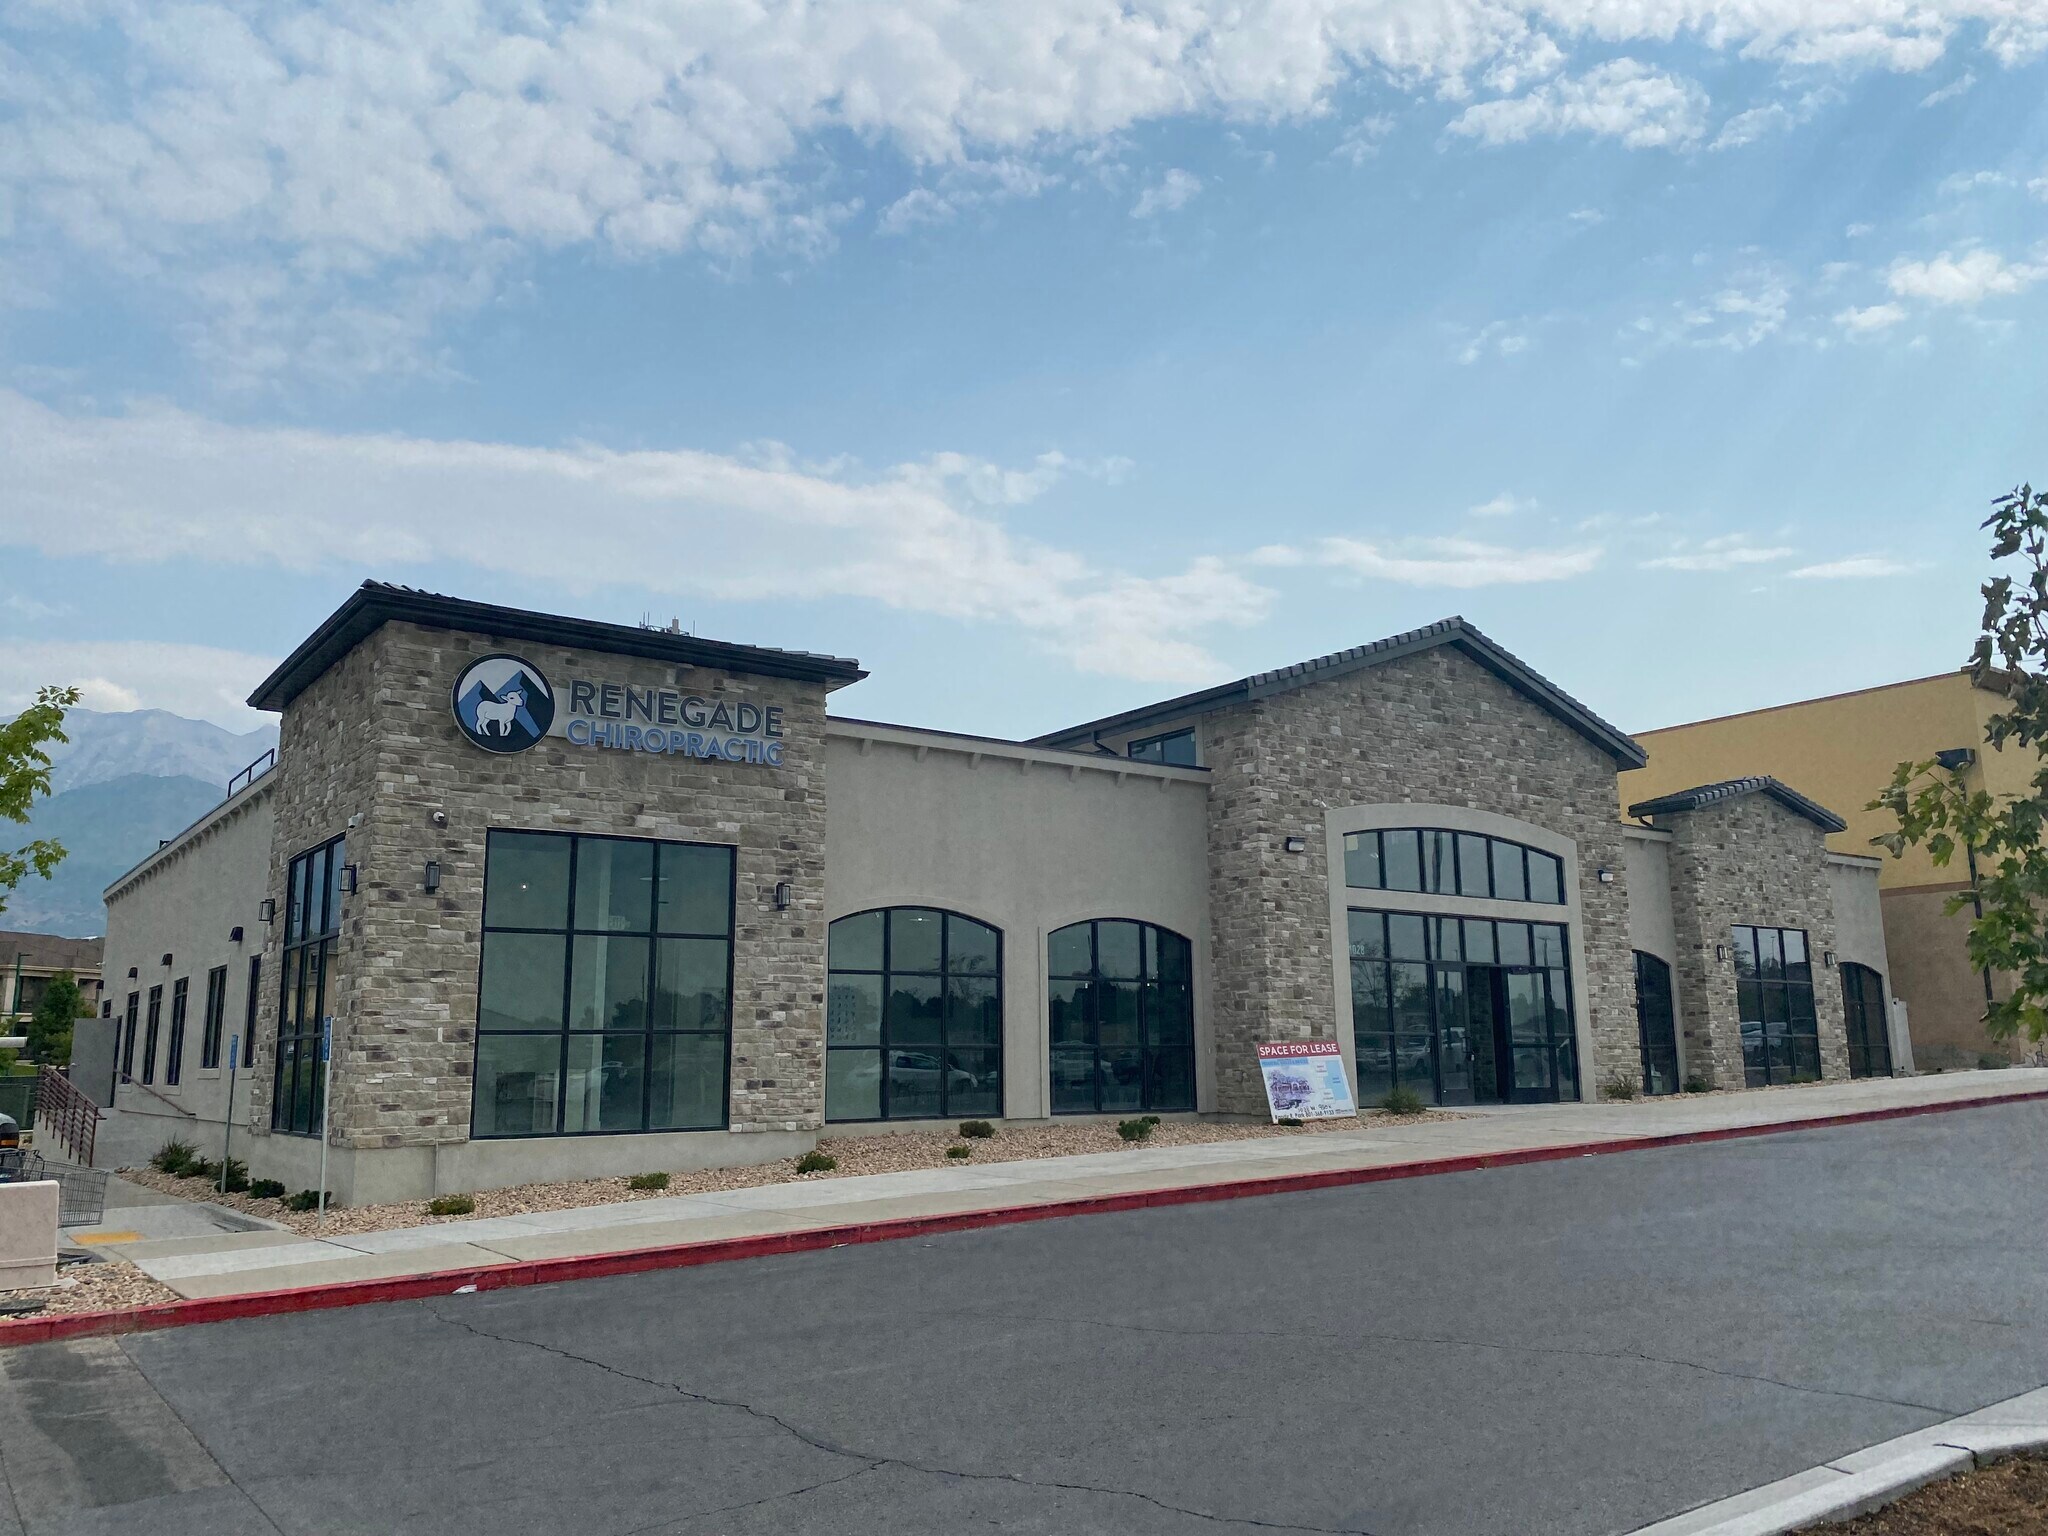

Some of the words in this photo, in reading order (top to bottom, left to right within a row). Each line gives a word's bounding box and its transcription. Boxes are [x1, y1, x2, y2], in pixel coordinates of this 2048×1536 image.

[569, 679, 785, 739] RENEGADE
[566, 718, 786, 767] CHIROPRACTIC
[1260, 1045, 1289, 1056] SPACE
[1290, 1044, 1308, 1055] FOR
[1310, 1043, 1338, 1053] LEASE
